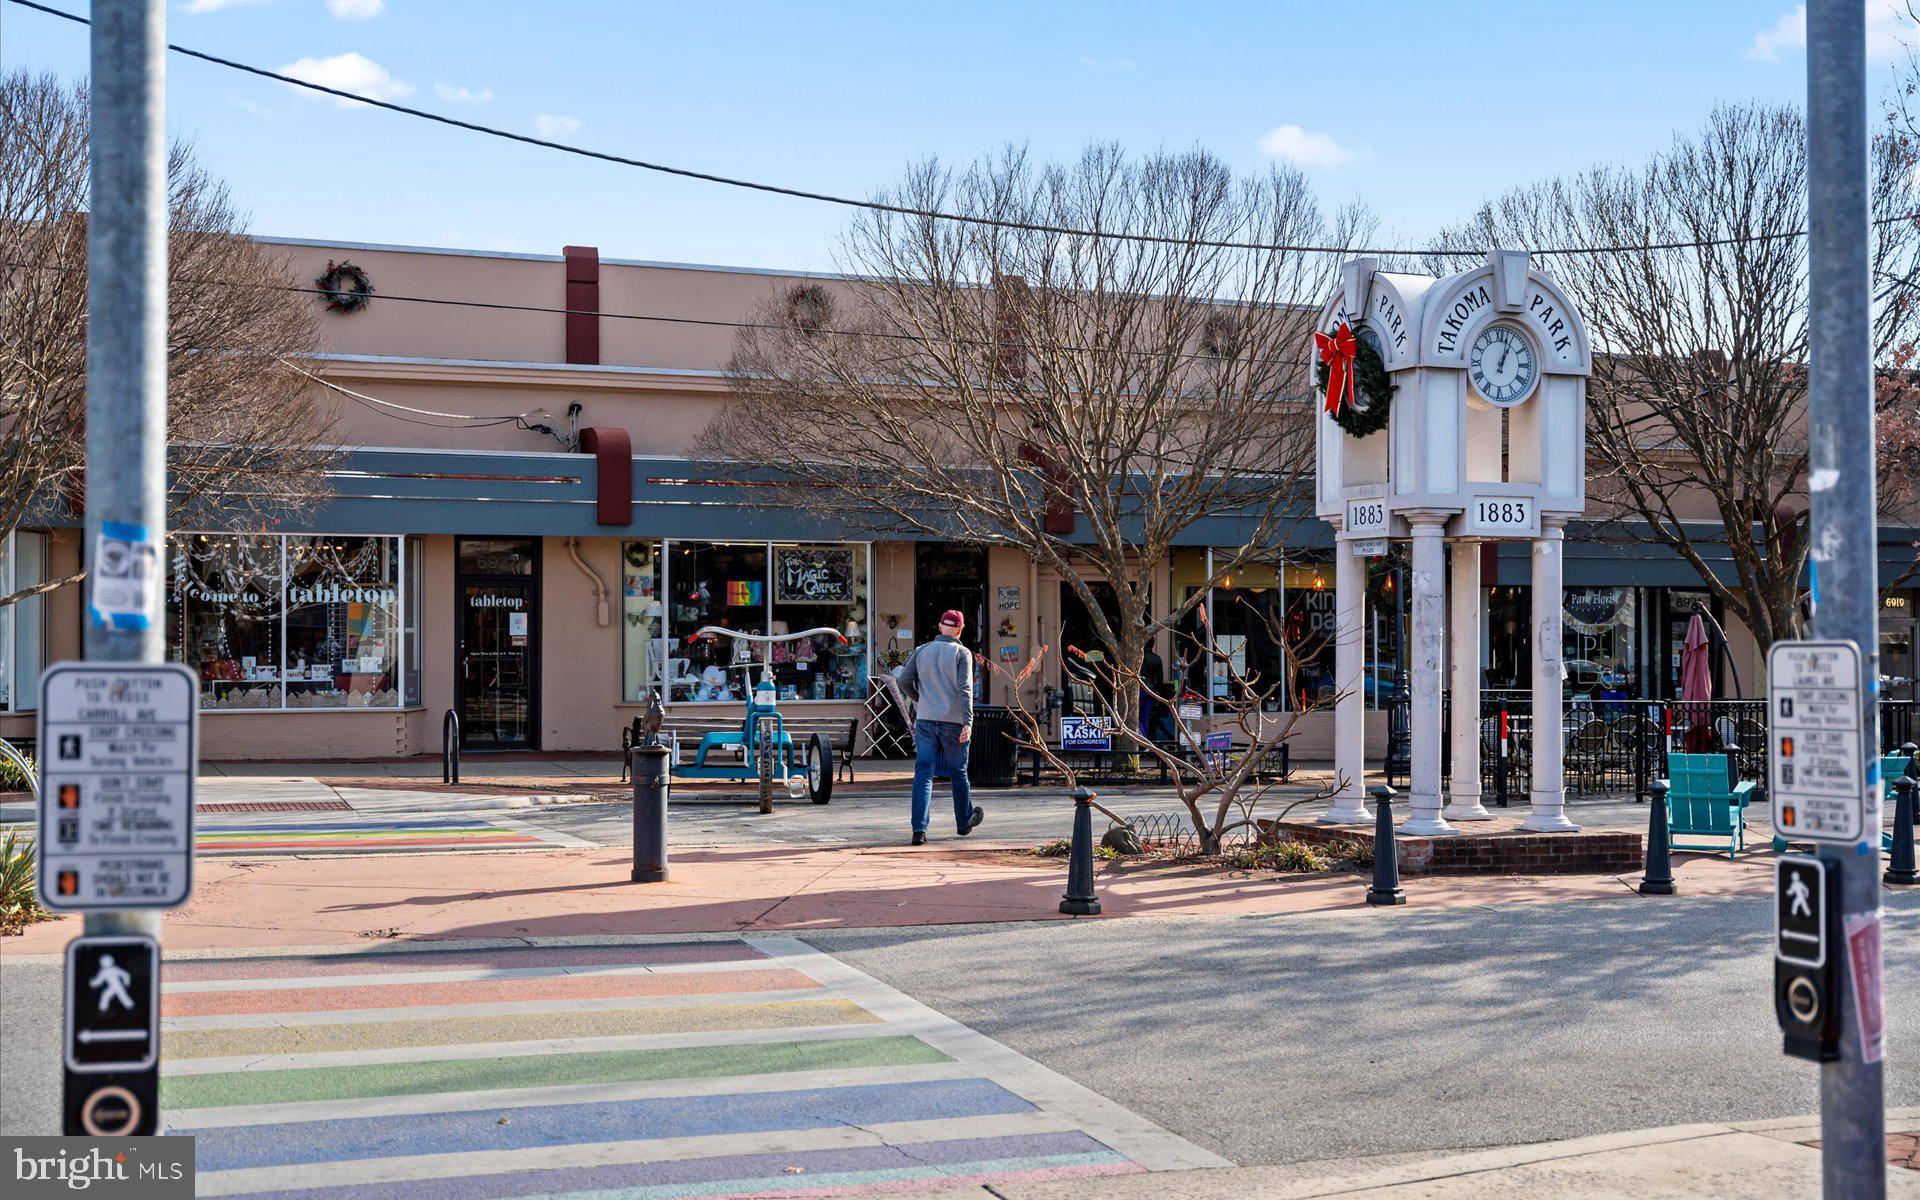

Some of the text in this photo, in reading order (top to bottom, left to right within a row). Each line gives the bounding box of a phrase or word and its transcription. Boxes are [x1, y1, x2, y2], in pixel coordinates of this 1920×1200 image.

[1379, 294, 1407, 349] PARK
[1438, 286, 1571, 354] TAKOMA PARK
[1354, 504, 1383, 526] 1883
[1479, 502, 1525, 523] 1883
[243, 591, 259, 603] to
[290, 583, 395, 609] tabletop
[470, 594, 523, 610] tabletop
[1571, 593, 1618, 604] Park Florist
[1885, 597, 1905, 608] 6919
